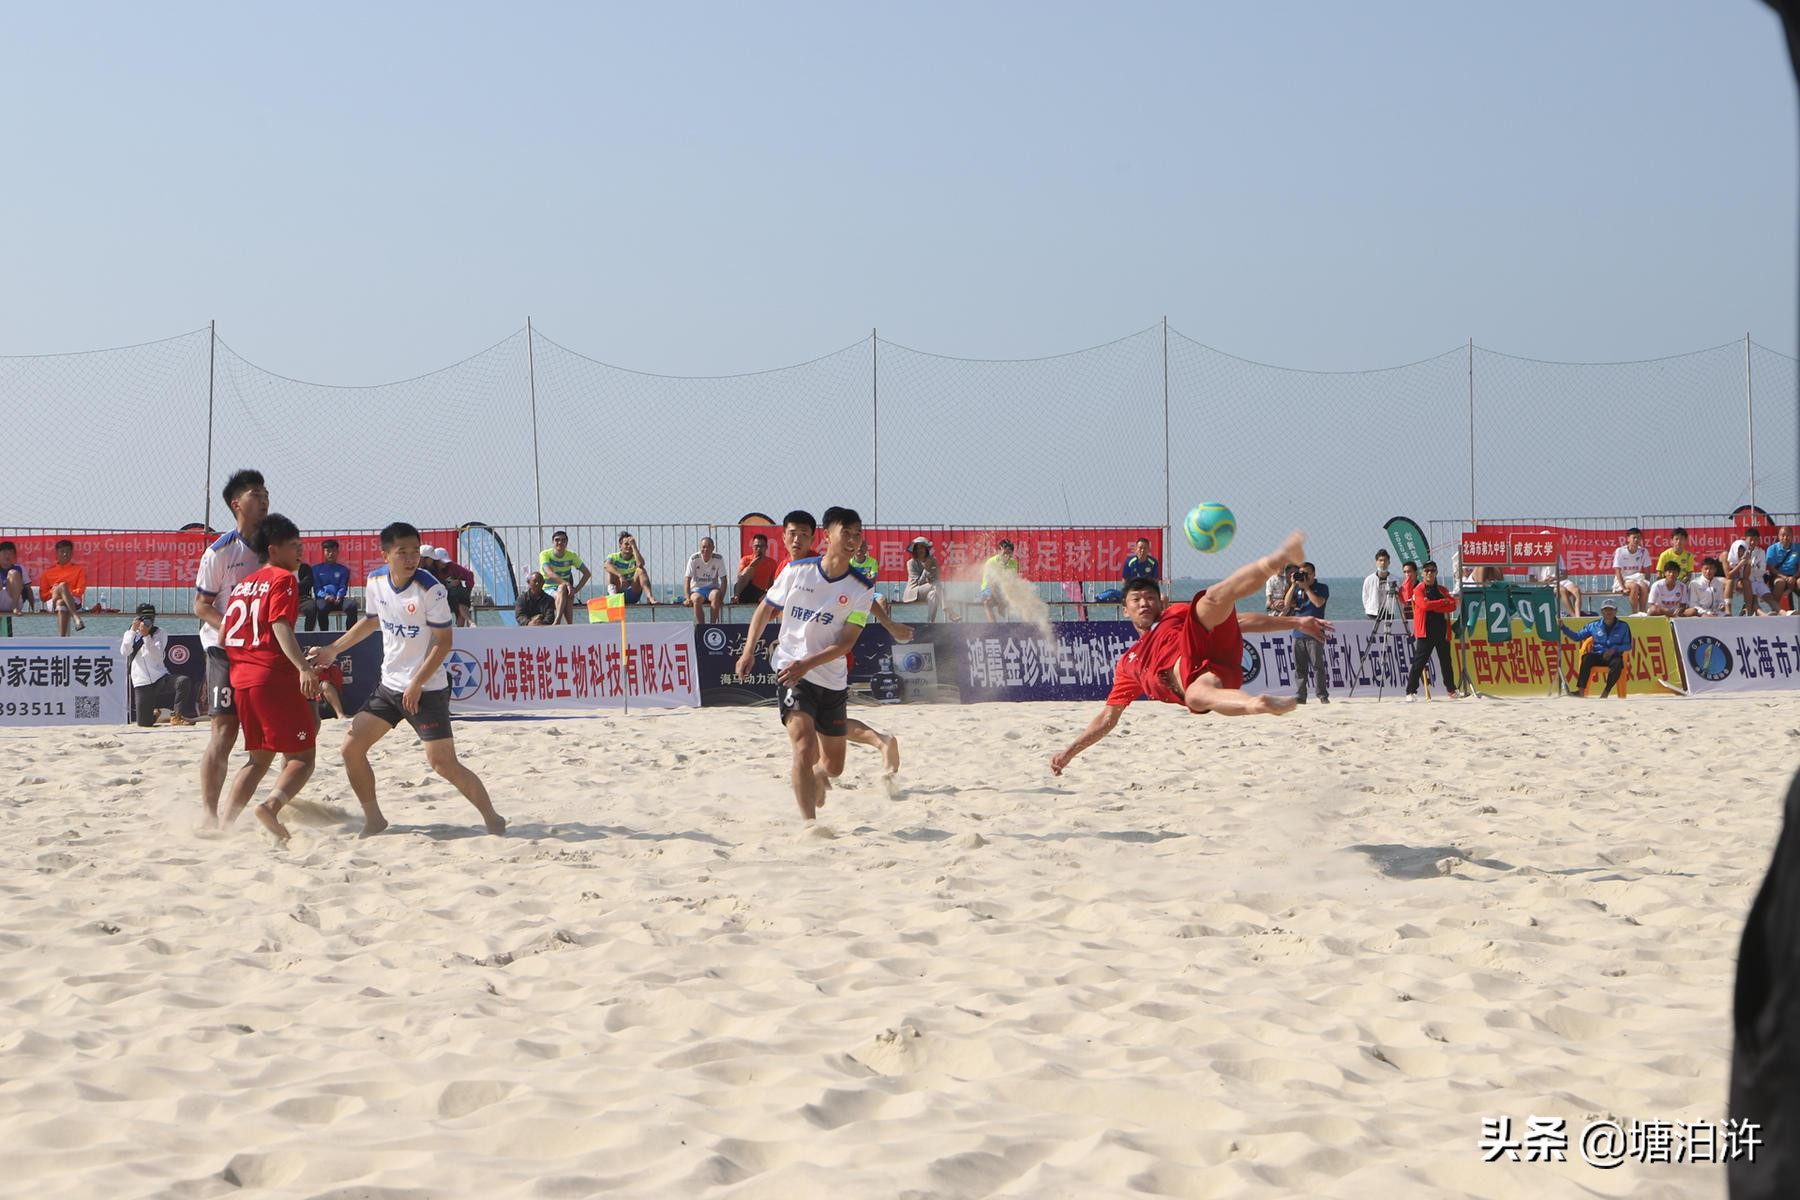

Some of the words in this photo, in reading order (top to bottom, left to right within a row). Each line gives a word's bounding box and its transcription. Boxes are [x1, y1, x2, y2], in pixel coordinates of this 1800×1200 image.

[104, 538, 142, 552] Guek
[1463, 541, 1506, 557] 北海市第九中学
[1513, 541, 1554, 557] 成都大学
[221, 598, 261, 647] 21
[791, 605, 834, 625] 成都大学
[1489, 602, 1509, 633] 2
[483, 642, 692, 702] 北海韩能生物科技有限公司
[213, 686, 232, 708] 13
[783, 687, 795, 707] 6
